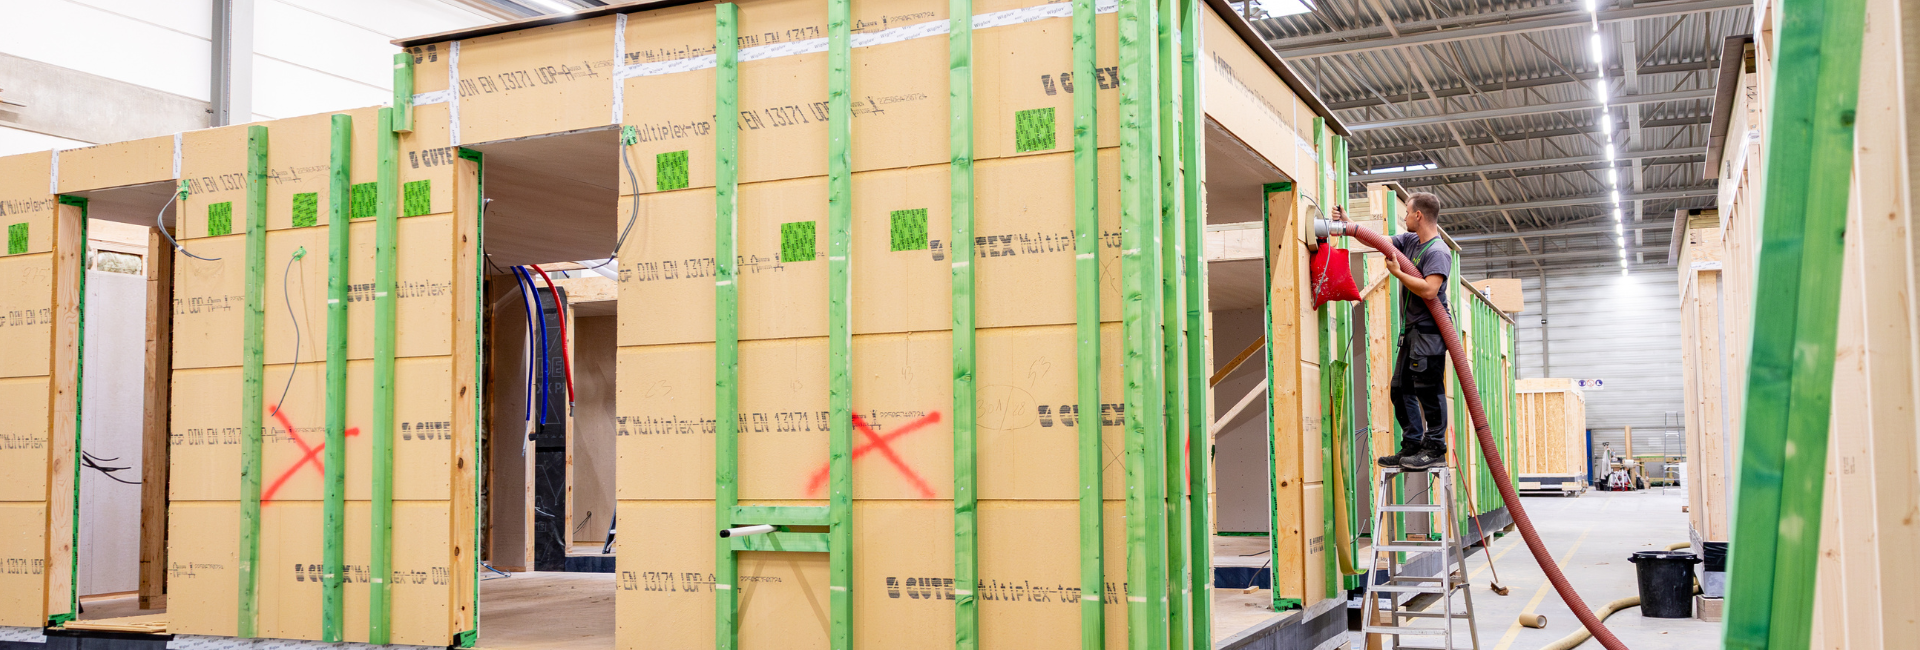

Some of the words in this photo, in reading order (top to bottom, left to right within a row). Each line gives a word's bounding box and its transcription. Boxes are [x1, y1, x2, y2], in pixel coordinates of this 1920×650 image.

[478, 75, 499, 93] EN
[498, 70, 536, 91] 13171
[1060, 66, 1120, 93] GEX
[740, 109, 765, 130] EN
[765, 104, 810, 128] 13171
[202, 176, 219, 193] EN
[636, 262, 659, 282] DIN
[662, 260, 680, 280] EN
[683, 257, 717, 279] 13171
[26, 309, 36, 326] EN
[753, 412, 770, 433] EN
[774, 411, 811, 432] 13171
[1059, 403, 1125, 427] GEX
[188, 427, 204, 446] DIN
[207, 428, 219, 445] EN
[622, 571, 638, 591] EN
[643, 571, 677, 592] 13171
[905, 577, 956, 601] GUTE
